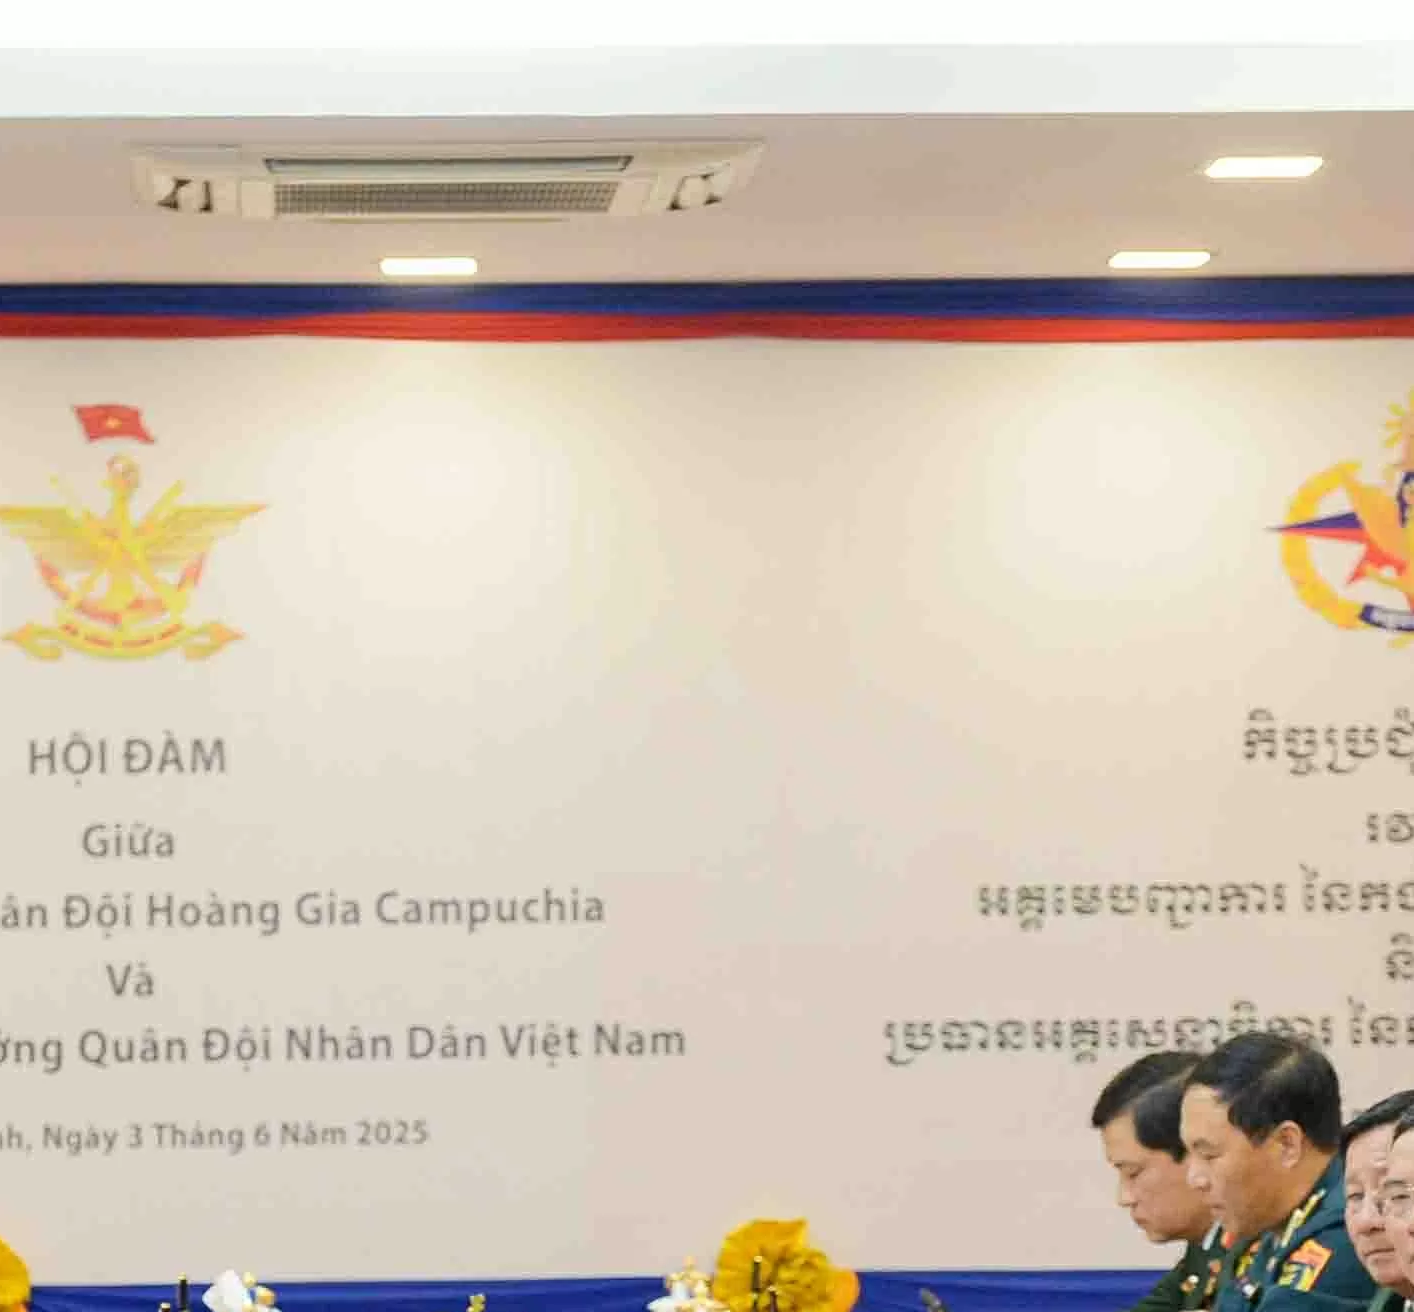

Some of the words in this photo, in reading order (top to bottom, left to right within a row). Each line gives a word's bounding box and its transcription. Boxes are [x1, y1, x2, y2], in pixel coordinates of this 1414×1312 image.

[29, 730, 107, 788] HỘI
[122, 729, 227, 775] ĐÀM
[81, 821, 176, 859] Giữa
[61, 891, 133, 939] Đội
[146, 890, 281, 938] Hoàng
[295, 890, 362, 926] Gia
[375, 888, 605, 935] Campuchia
[105, 962, 156, 998] Và
[77, 1027, 189, 1069] Quân
[201, 1025, 272, 1073] Đội
[285, 1023, 394, 1062] Nhân
[407, 1023, 488, 1061] Dân
[498, 1022, 581, 1068] Việt
[593, 1023, 687, 1058] Nam
[42, 1122, 120, 1158] Ngày
[128, 1123, 144, 1149] 3
[152, 1121, 246, 1156] Tháng
[253, 1122, 272, 1148] 6
[357, 1119, 430, 1146] 2025
